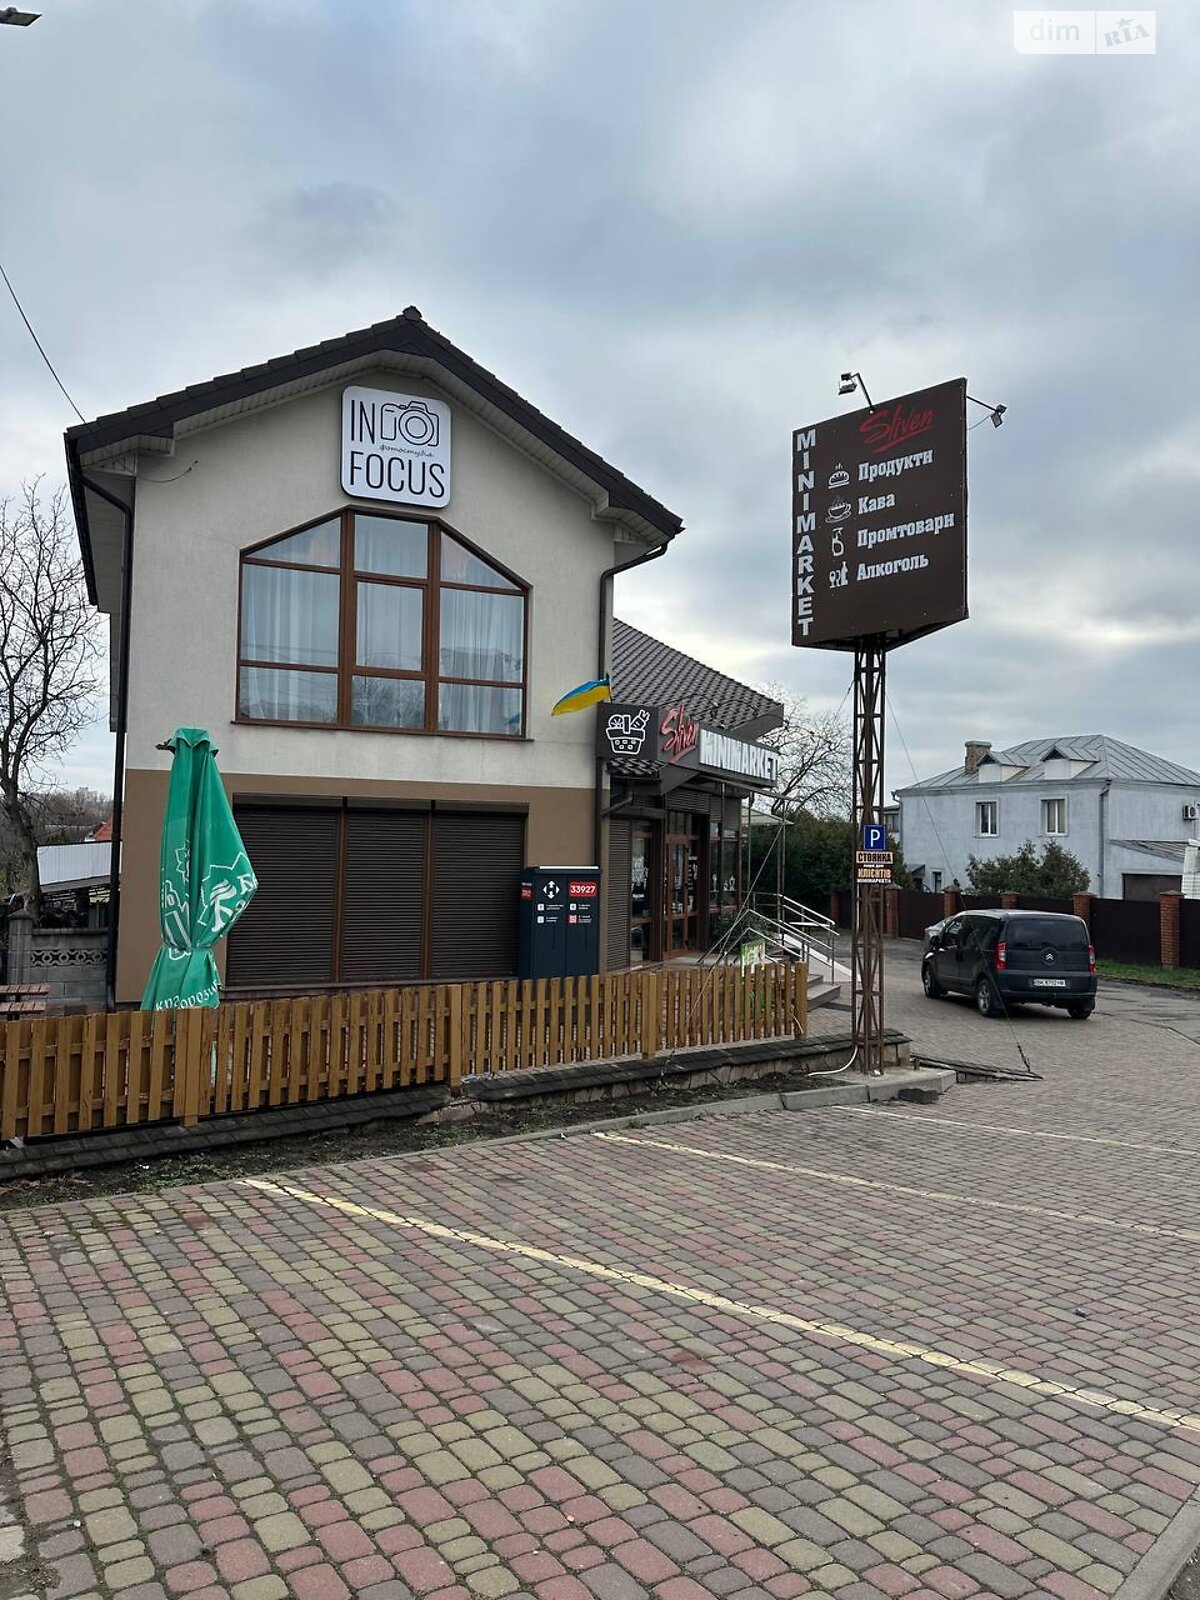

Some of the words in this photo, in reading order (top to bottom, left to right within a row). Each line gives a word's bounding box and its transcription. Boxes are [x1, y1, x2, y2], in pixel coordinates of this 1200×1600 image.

[351, 399, 375, 445] IN
[859, 402, 935, 450] Sliven
[350, 450, 445, 498] FOCUS
[858, 449, 934, 482] Продукти
[858, 492, 895, 515] Кава
[796, 428, 817, 636] MINIMARKET
[857, 512, 955, 549] Промтовари
[857, 552, 929, 581] Алкоголь
[700, 728, 778, 781] MINIMARKET
[870, 829, 881, 848] P
[858, 852, 891, 862] СТОЯНКА
[570, 884, 596, 894] 33927
